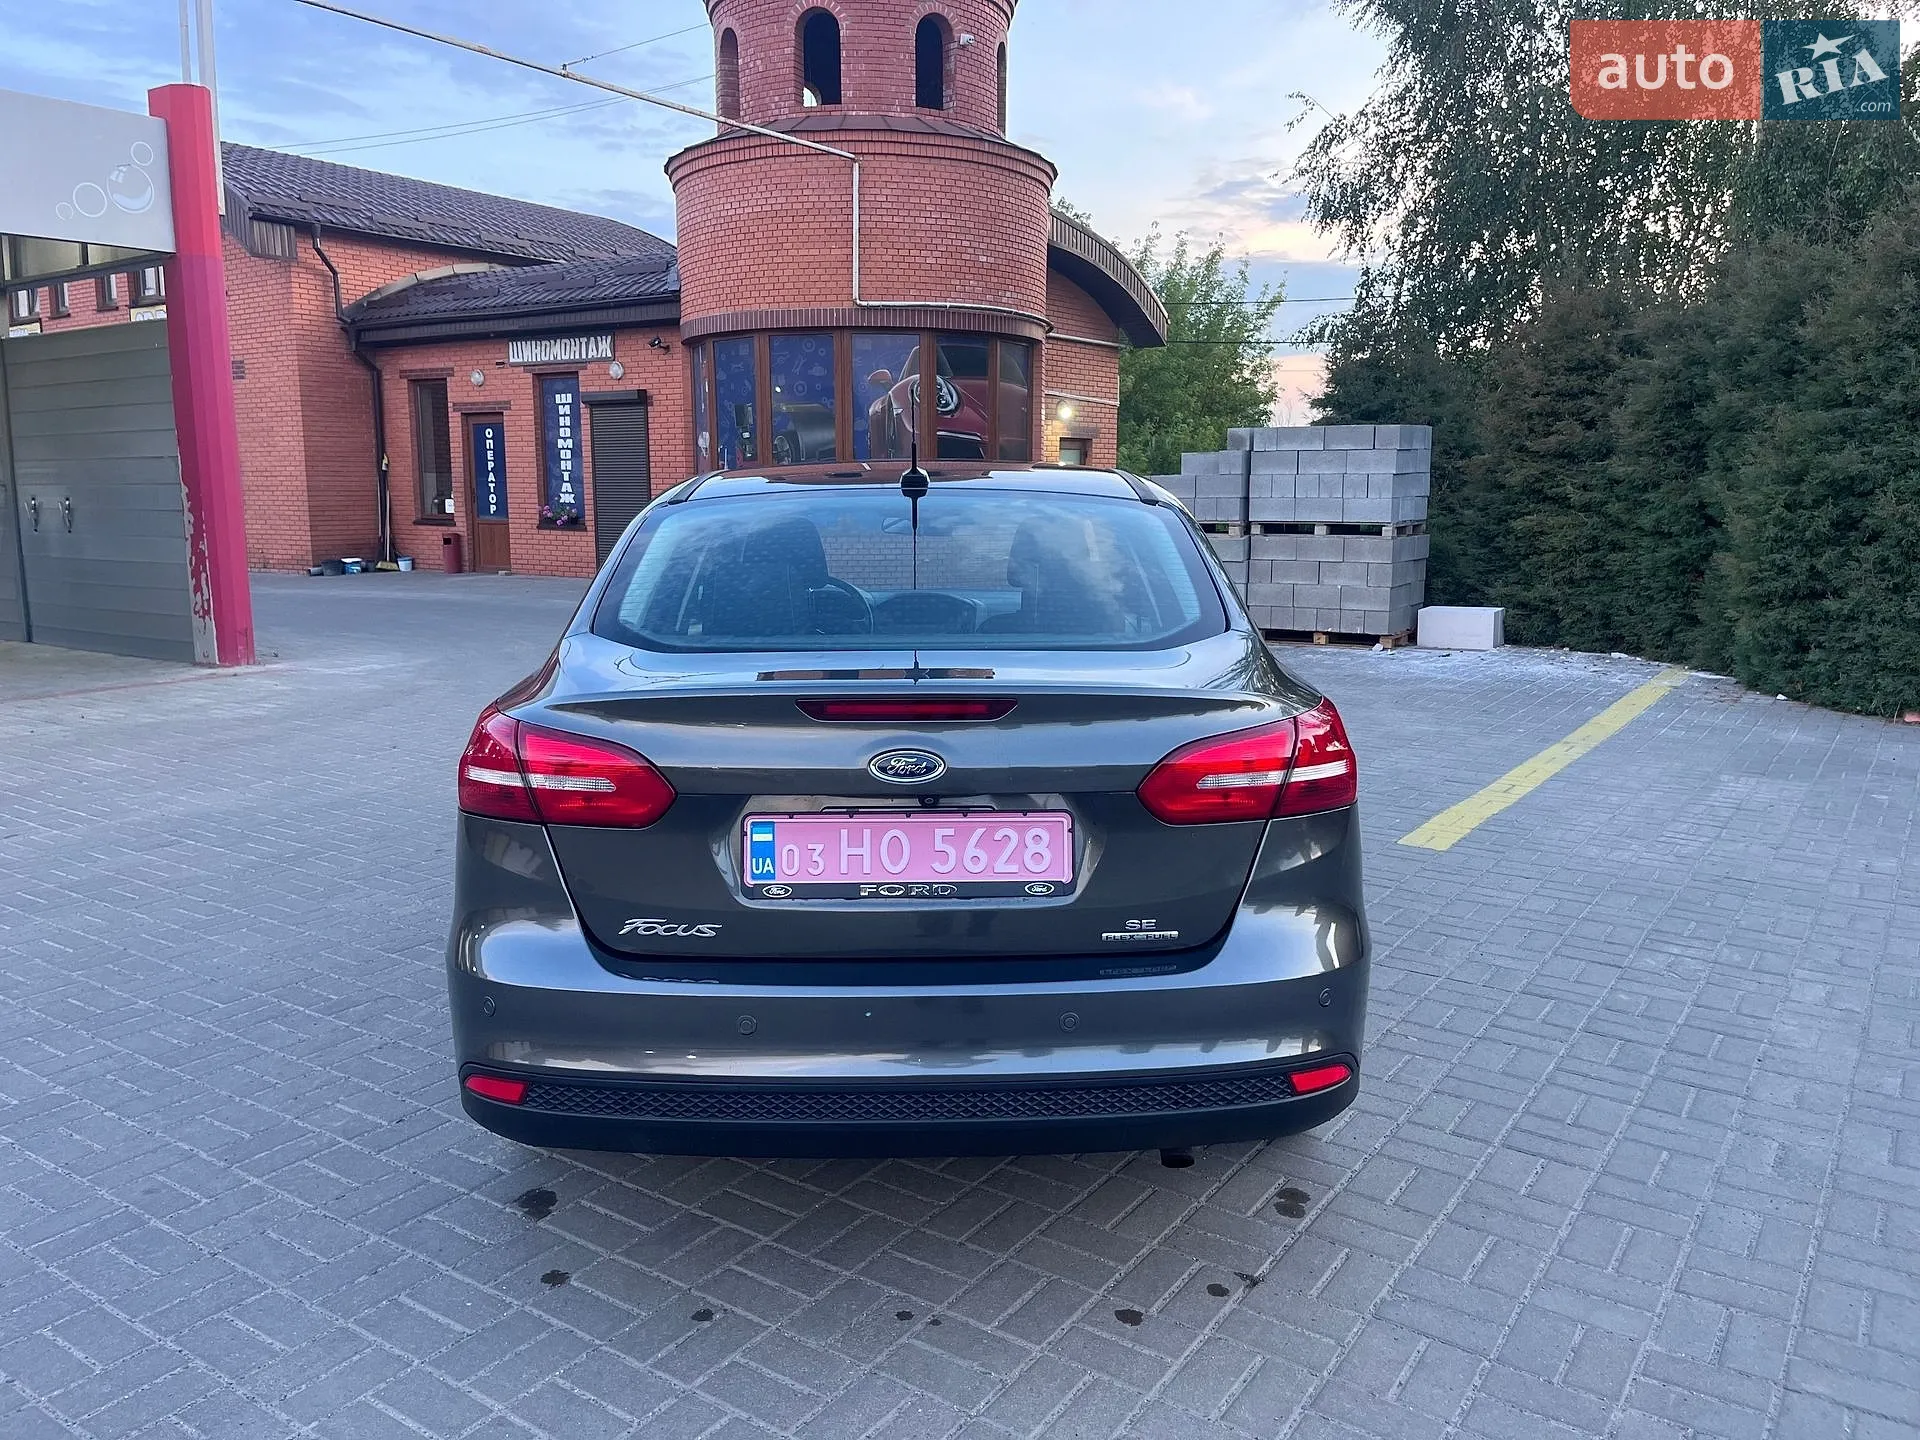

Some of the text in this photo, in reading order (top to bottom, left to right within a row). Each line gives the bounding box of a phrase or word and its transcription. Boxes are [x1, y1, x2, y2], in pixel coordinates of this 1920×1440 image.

[508, 335, 613, 363] ШИНОМОНТАЖ
[555, 393, 576, 504] ШИНОМОНТАЖ
[485, 428, 497, 514] ОПЕРАТОР
[886, 757, 928, 775] Ford
[781, 826, 1053, 876] 03 HO 5628
[752, 857, 774, 874] UA
[859, 884, 958, 896] FORD
[1125, 919, 1156, 930] SE
